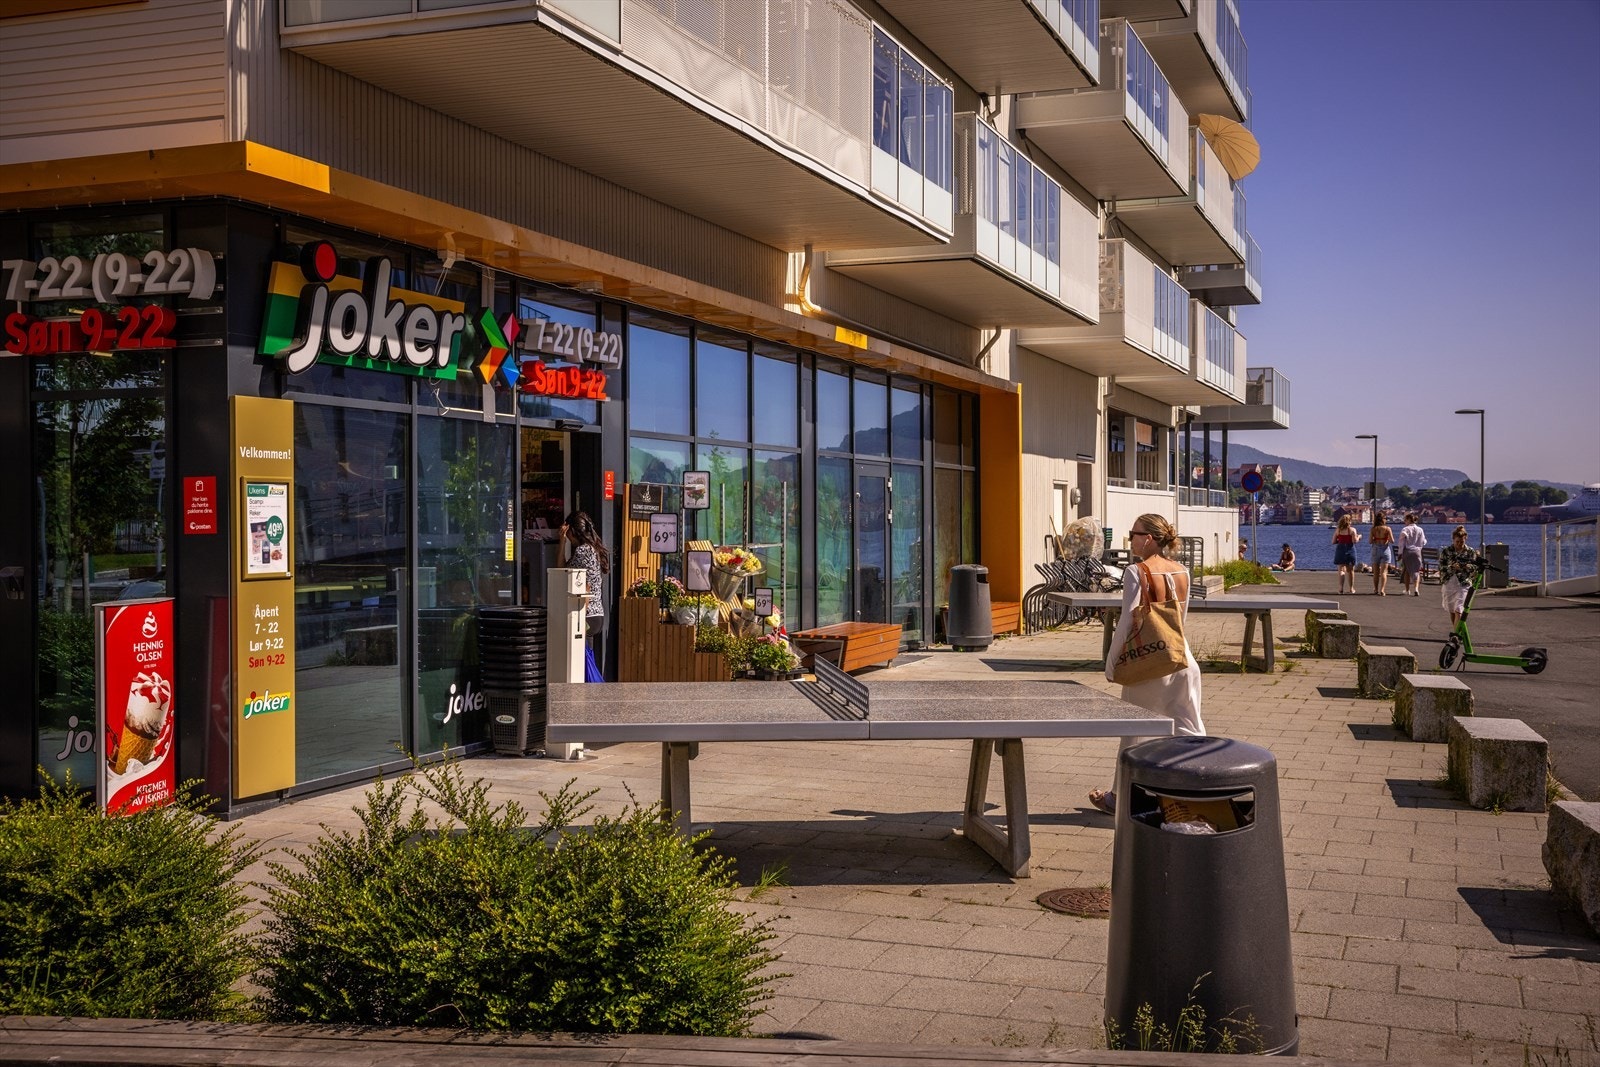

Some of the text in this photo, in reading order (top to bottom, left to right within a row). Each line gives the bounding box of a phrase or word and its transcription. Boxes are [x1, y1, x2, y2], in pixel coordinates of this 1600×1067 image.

[3, 248, 215, 303] 7-22 (9-22)
[287, 240, 465, 375] joker
[5, 305, 176, 355] Søn 9-22
[535, 318, 623, 369] 7-22 (9-22)
[535, 360, 607, 400] Søn 9-22
[240, 446, 291, 460] Velkommen!
[254, 604, 279, 619] Åpent
[255, 624, 261, 634] 7
[268, 622, 279, 634] 22
[133, 639, 164, 653] HENNIG
[249, 638, 284, 652] Lør 9-22
[136, 650, 163, 663] OLSEN
[248, 654, 285, 668] Søn 9-22
[245, 689, 288, 719] joker
[132, 795, 144, 807] AV
